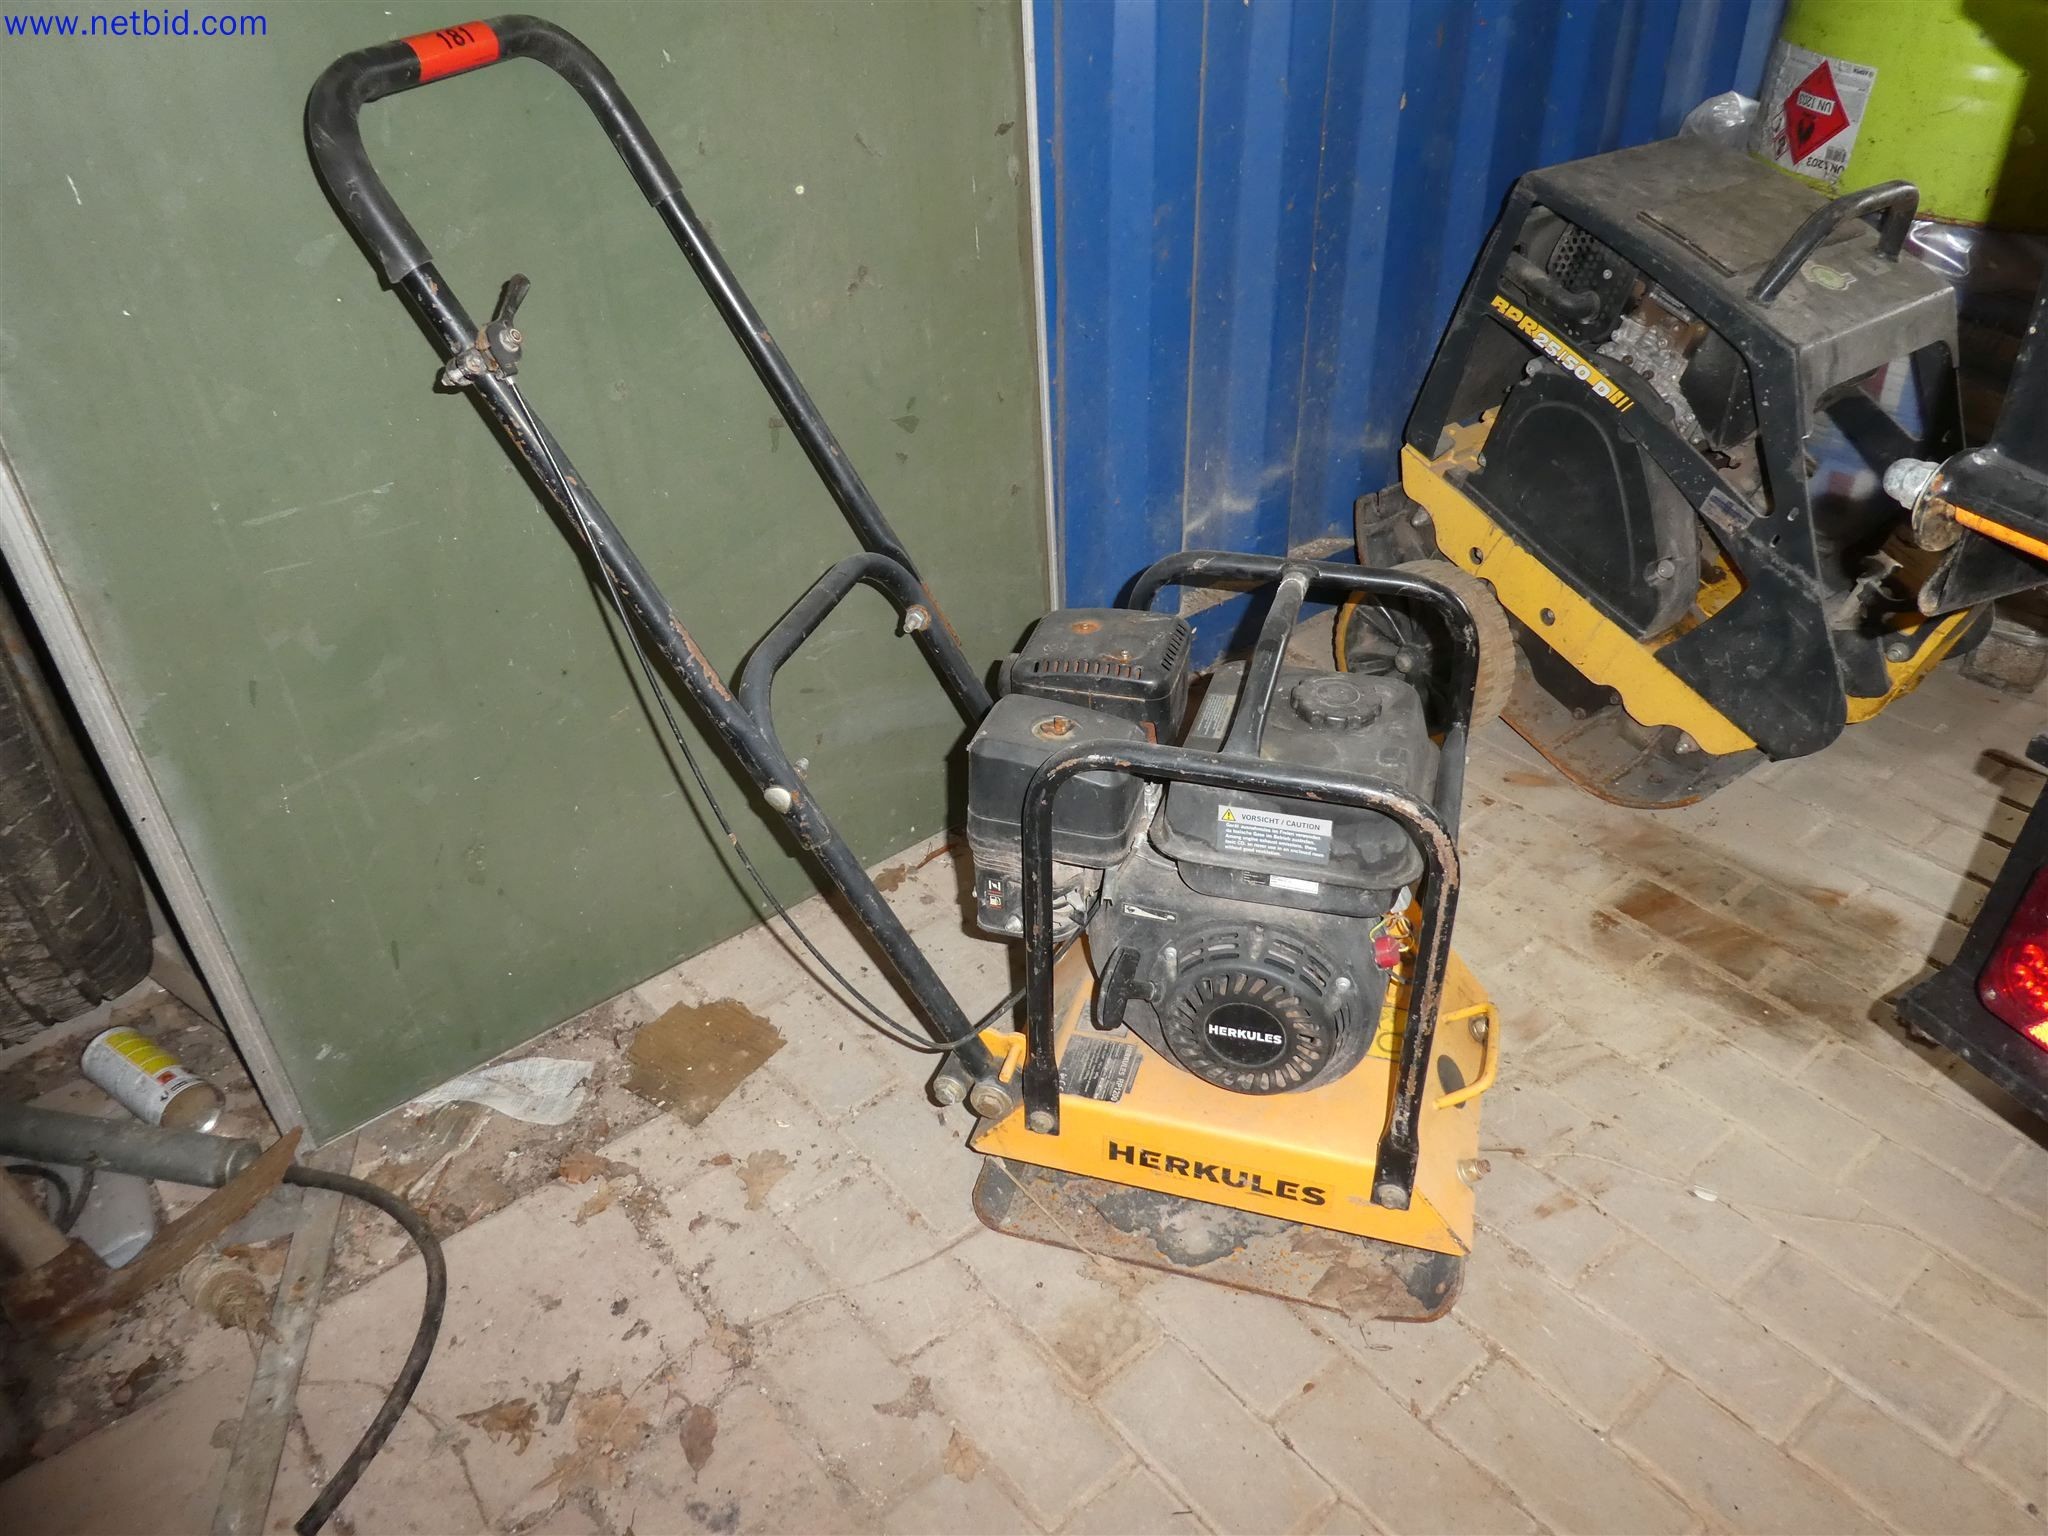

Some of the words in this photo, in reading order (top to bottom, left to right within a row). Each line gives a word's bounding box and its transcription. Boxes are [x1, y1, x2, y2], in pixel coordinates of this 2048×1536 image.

[436, 26, 475, 49] 181
[1241, 813, 1279, 825] VORSICHT
[1286, 819, 1321, 831] CAUTION
[1208, 1023, 1282, 1045] HERKULES
[1109, 1140, 1326, 1206] HERKULES
